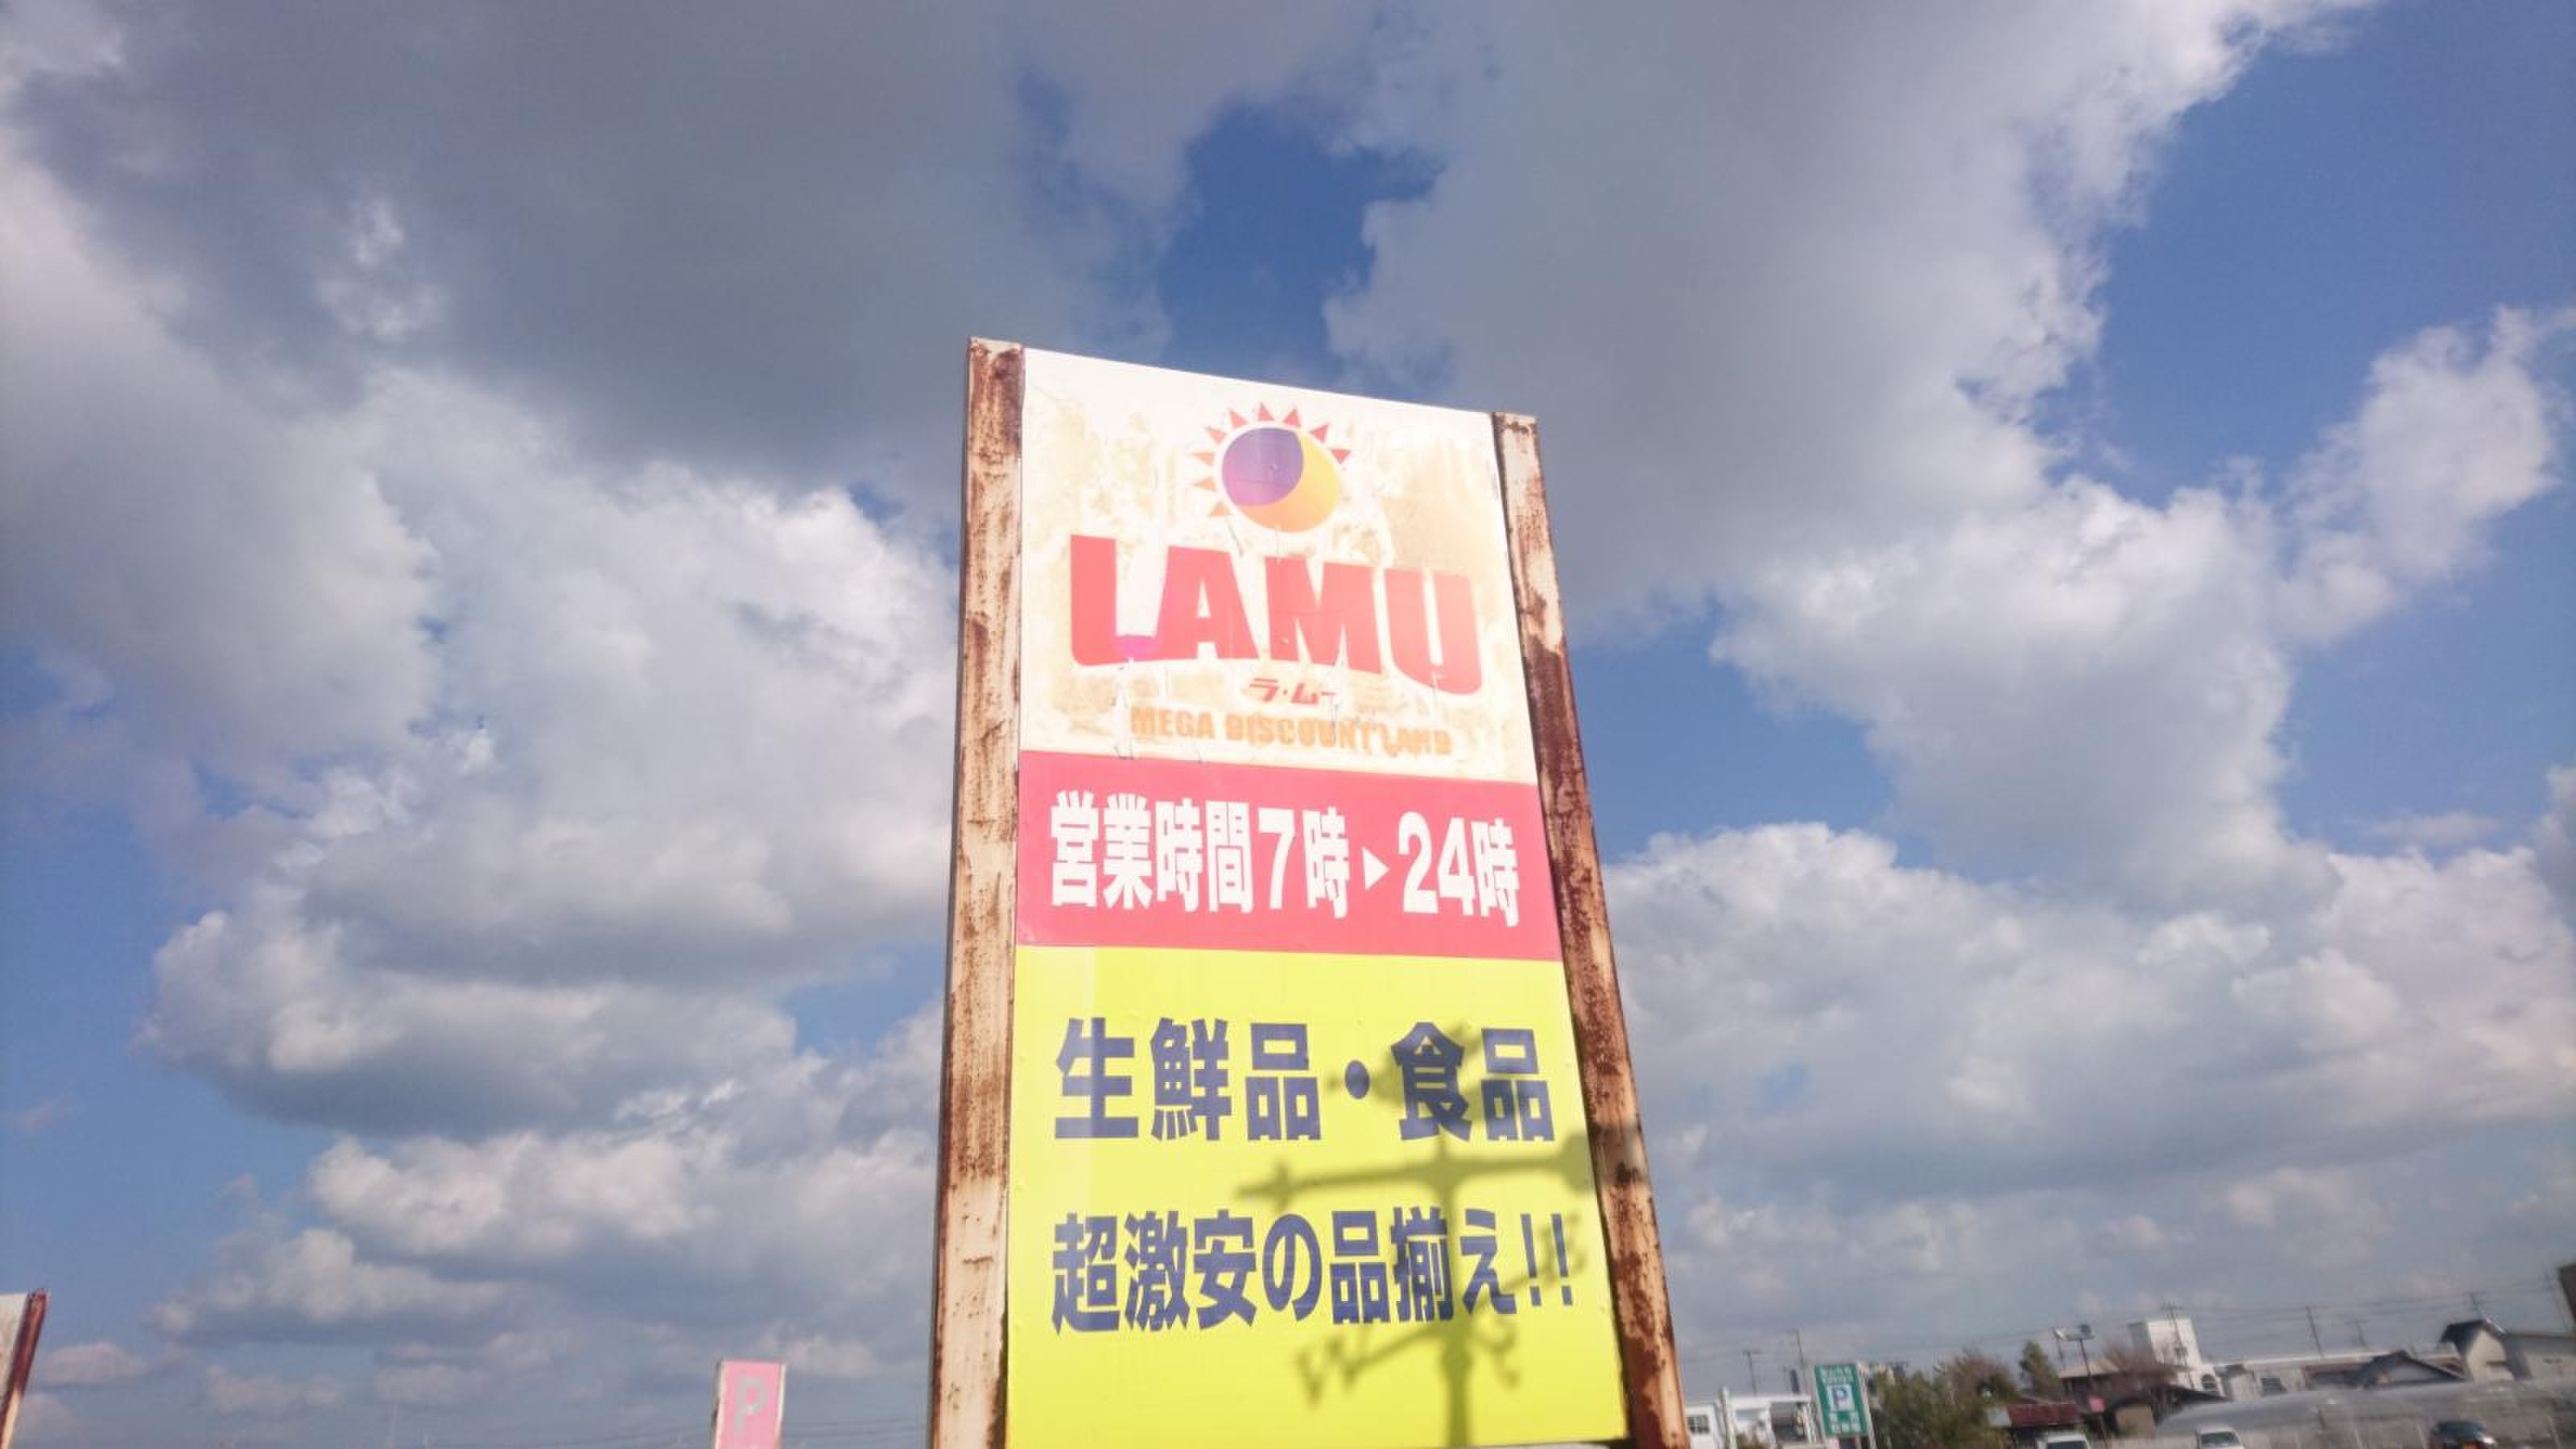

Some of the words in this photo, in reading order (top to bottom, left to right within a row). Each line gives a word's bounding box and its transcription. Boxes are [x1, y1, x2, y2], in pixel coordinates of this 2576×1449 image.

[1071, 535, 1482, 696] LAMU
[1129, 706, 1215, 740] MEGA
[733, 1373, 769, 1437] P
[1831, 1386, 1847, 1409] P
